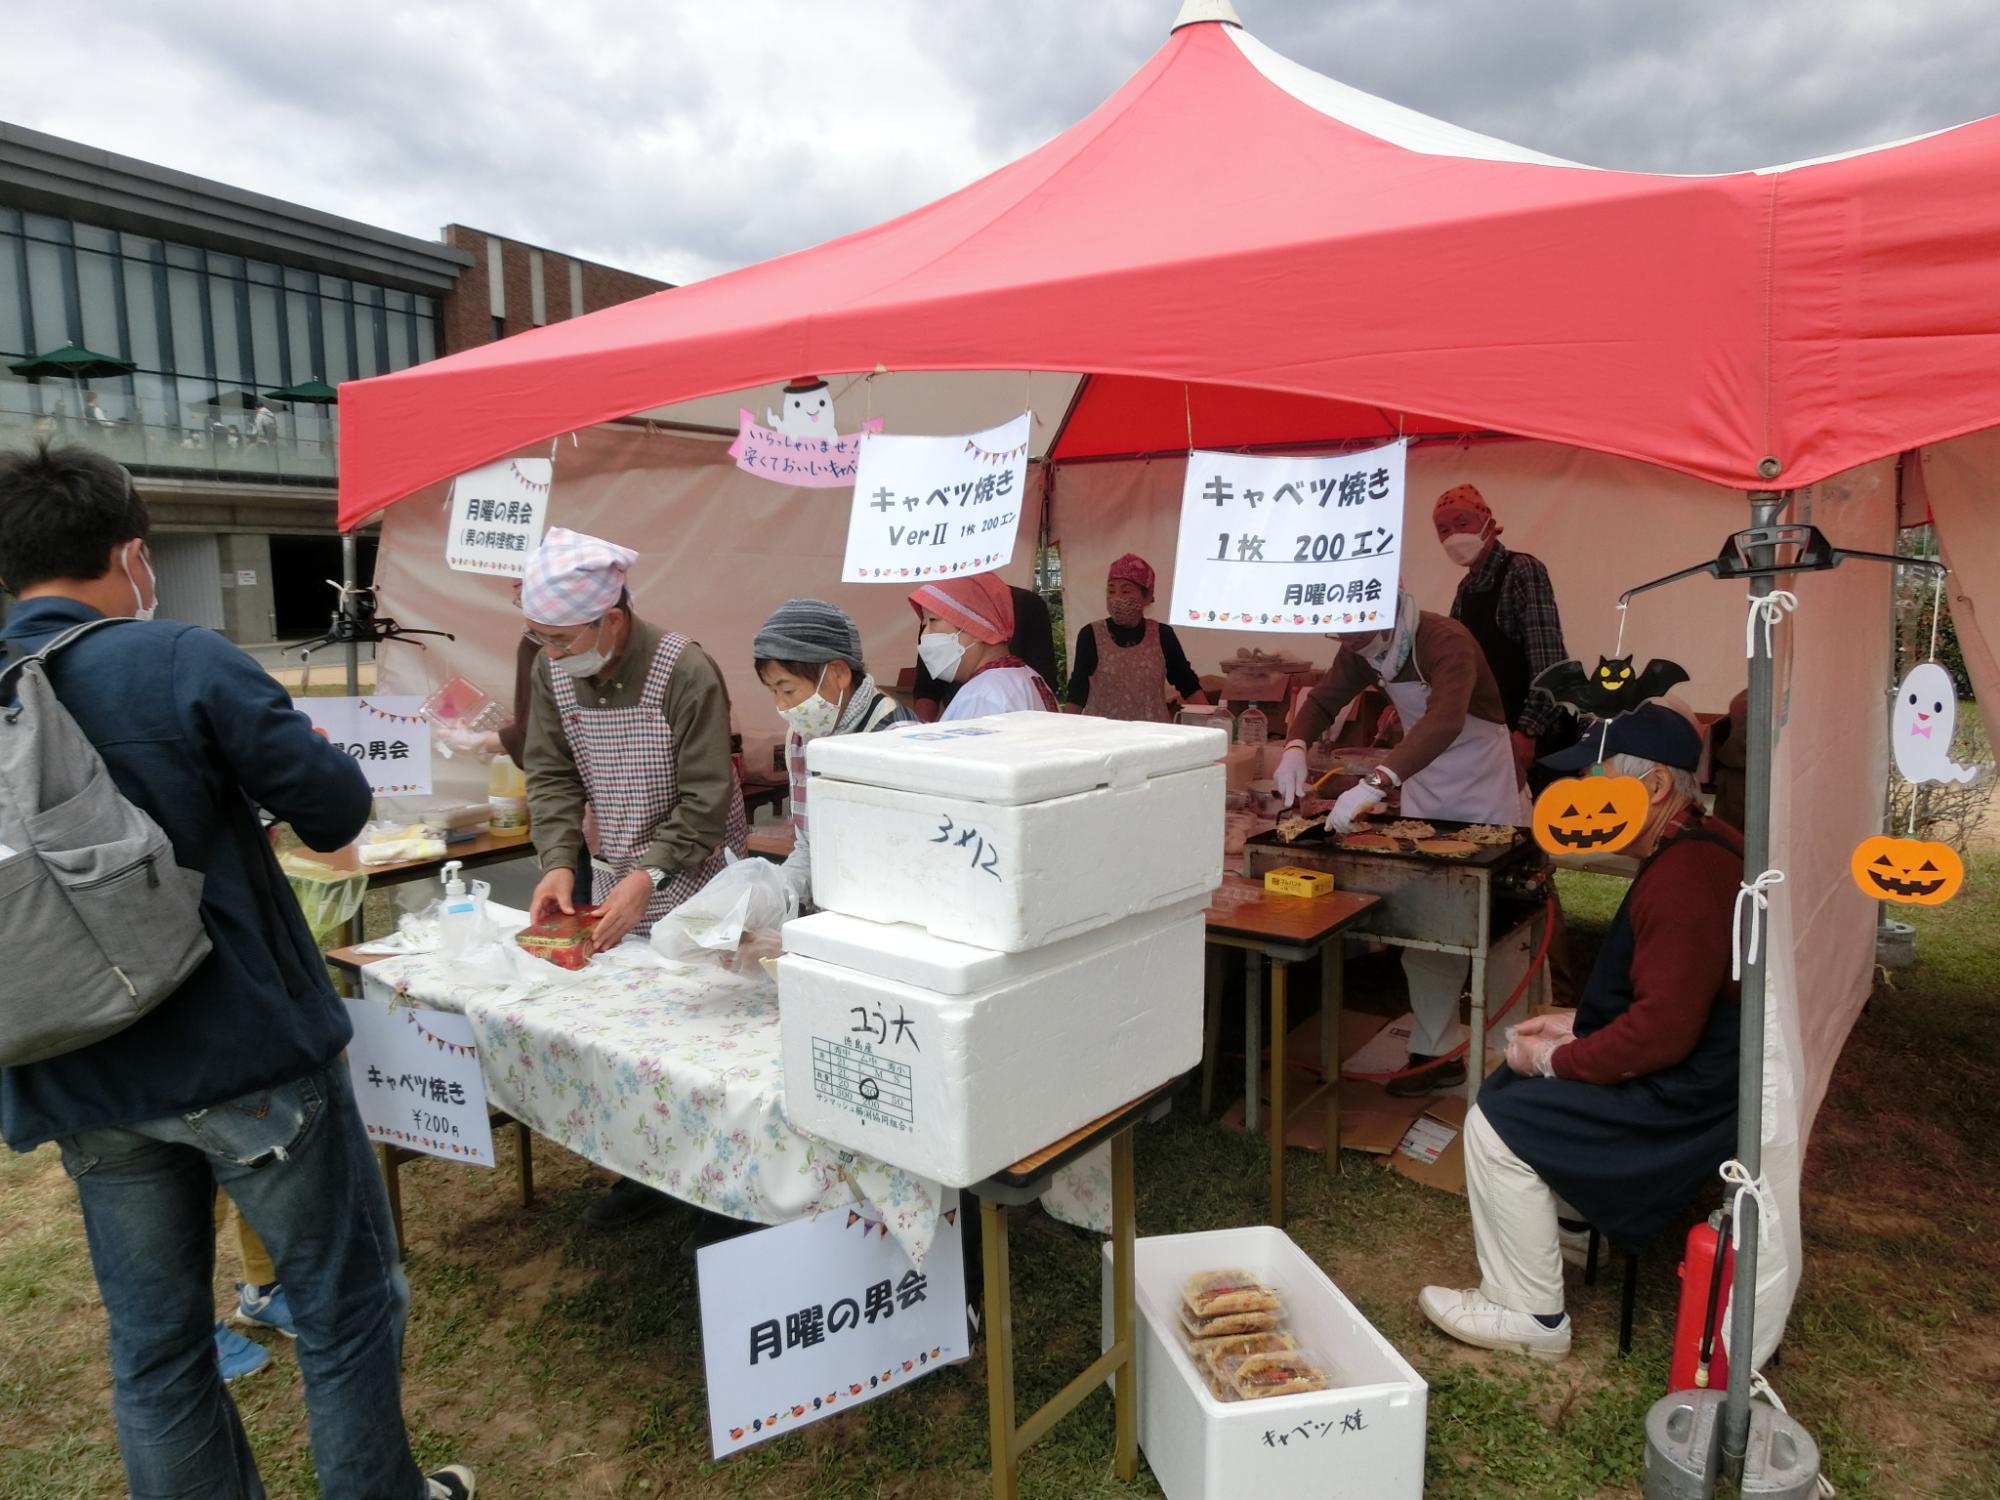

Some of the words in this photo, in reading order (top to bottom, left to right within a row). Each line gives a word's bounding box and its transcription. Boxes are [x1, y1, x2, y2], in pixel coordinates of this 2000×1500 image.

[749, 430, 860, 455] いらっしゃいませ!
[743, 446, 859, 478] 安くておいしいキャベ
[870, 469, 1014, 513] キャベツ焼き
[1202, 467, 1390, 509] キャベツ焼き
[466, 498, 533, 525] 月曜の男会
[1217, 532, 1266, 562] 1枚
[1283, 577, 1382, 606] 月曜の男会
[367, 1064, 466, 1105] キャベツ焼き
[750, 1269, 928, 1366] 月曜の男会
